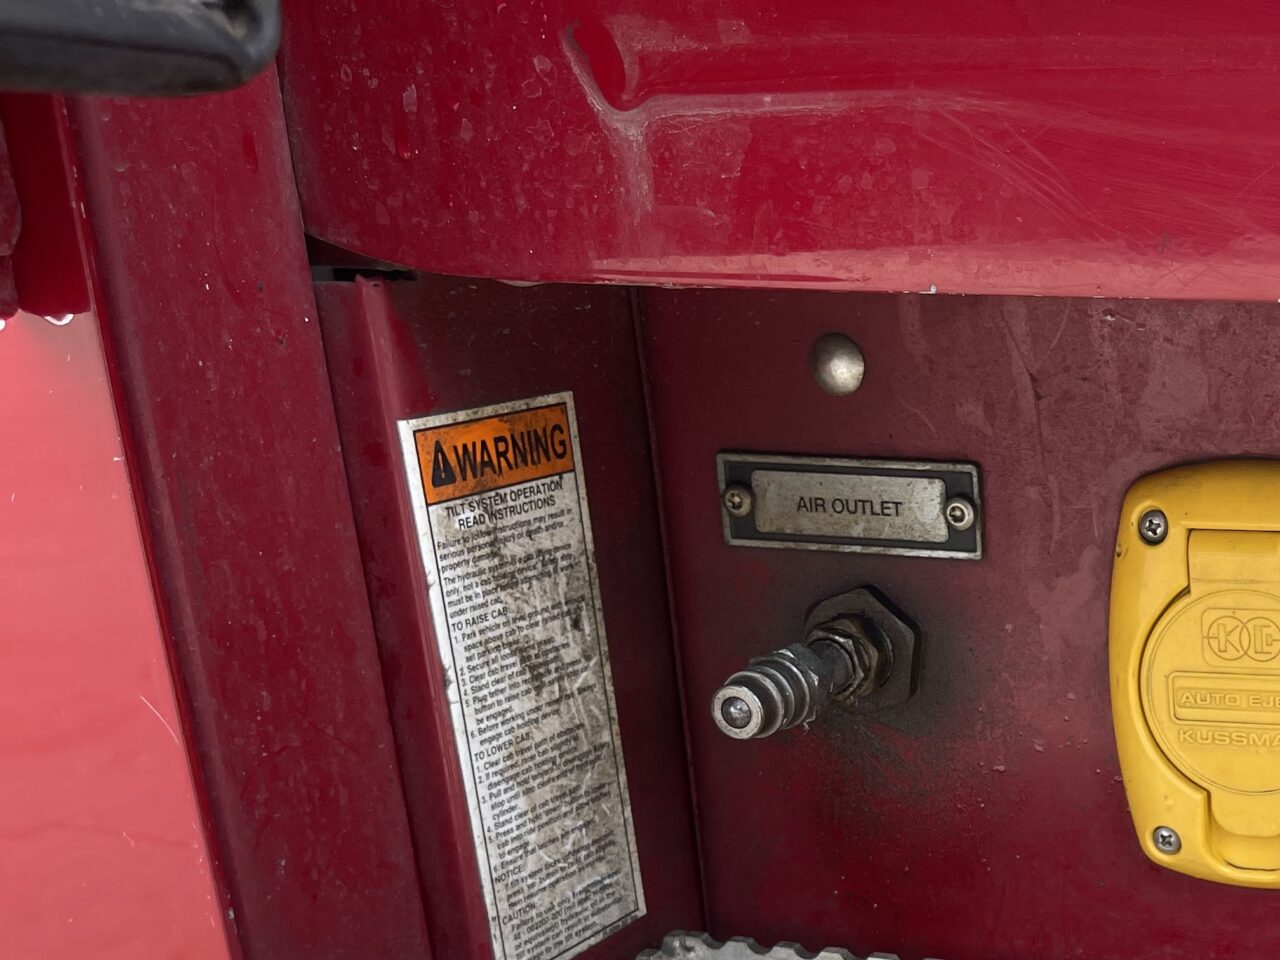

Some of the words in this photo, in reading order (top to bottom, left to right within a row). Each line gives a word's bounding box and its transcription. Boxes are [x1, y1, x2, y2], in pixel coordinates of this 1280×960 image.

[454, 424, 567, 482] WARNING
[446, 503, 466, 518] TILT
[469, 493, 508, 512] SYSTEM
[509, 479, 563, 502] OPERATION
[797, 496, 826, 513] AIR
[831, 498, 902, 517] OUTLET
[458, 514, 486, 530] READ
[488, 496, 556, 522] INSTRUCTIONS
[439, 547, 465, 561] serious
[441, 556, 470, 573] property
[449, 606, 468, 618] under
[465, 613, 489, 627] RAISE
[461, 630, 477, 641] Park
[1180, 691, 1241, 706] AUTO
[478, 721, 499, 735] Before
[486, 739, 514, 757] LOWER
